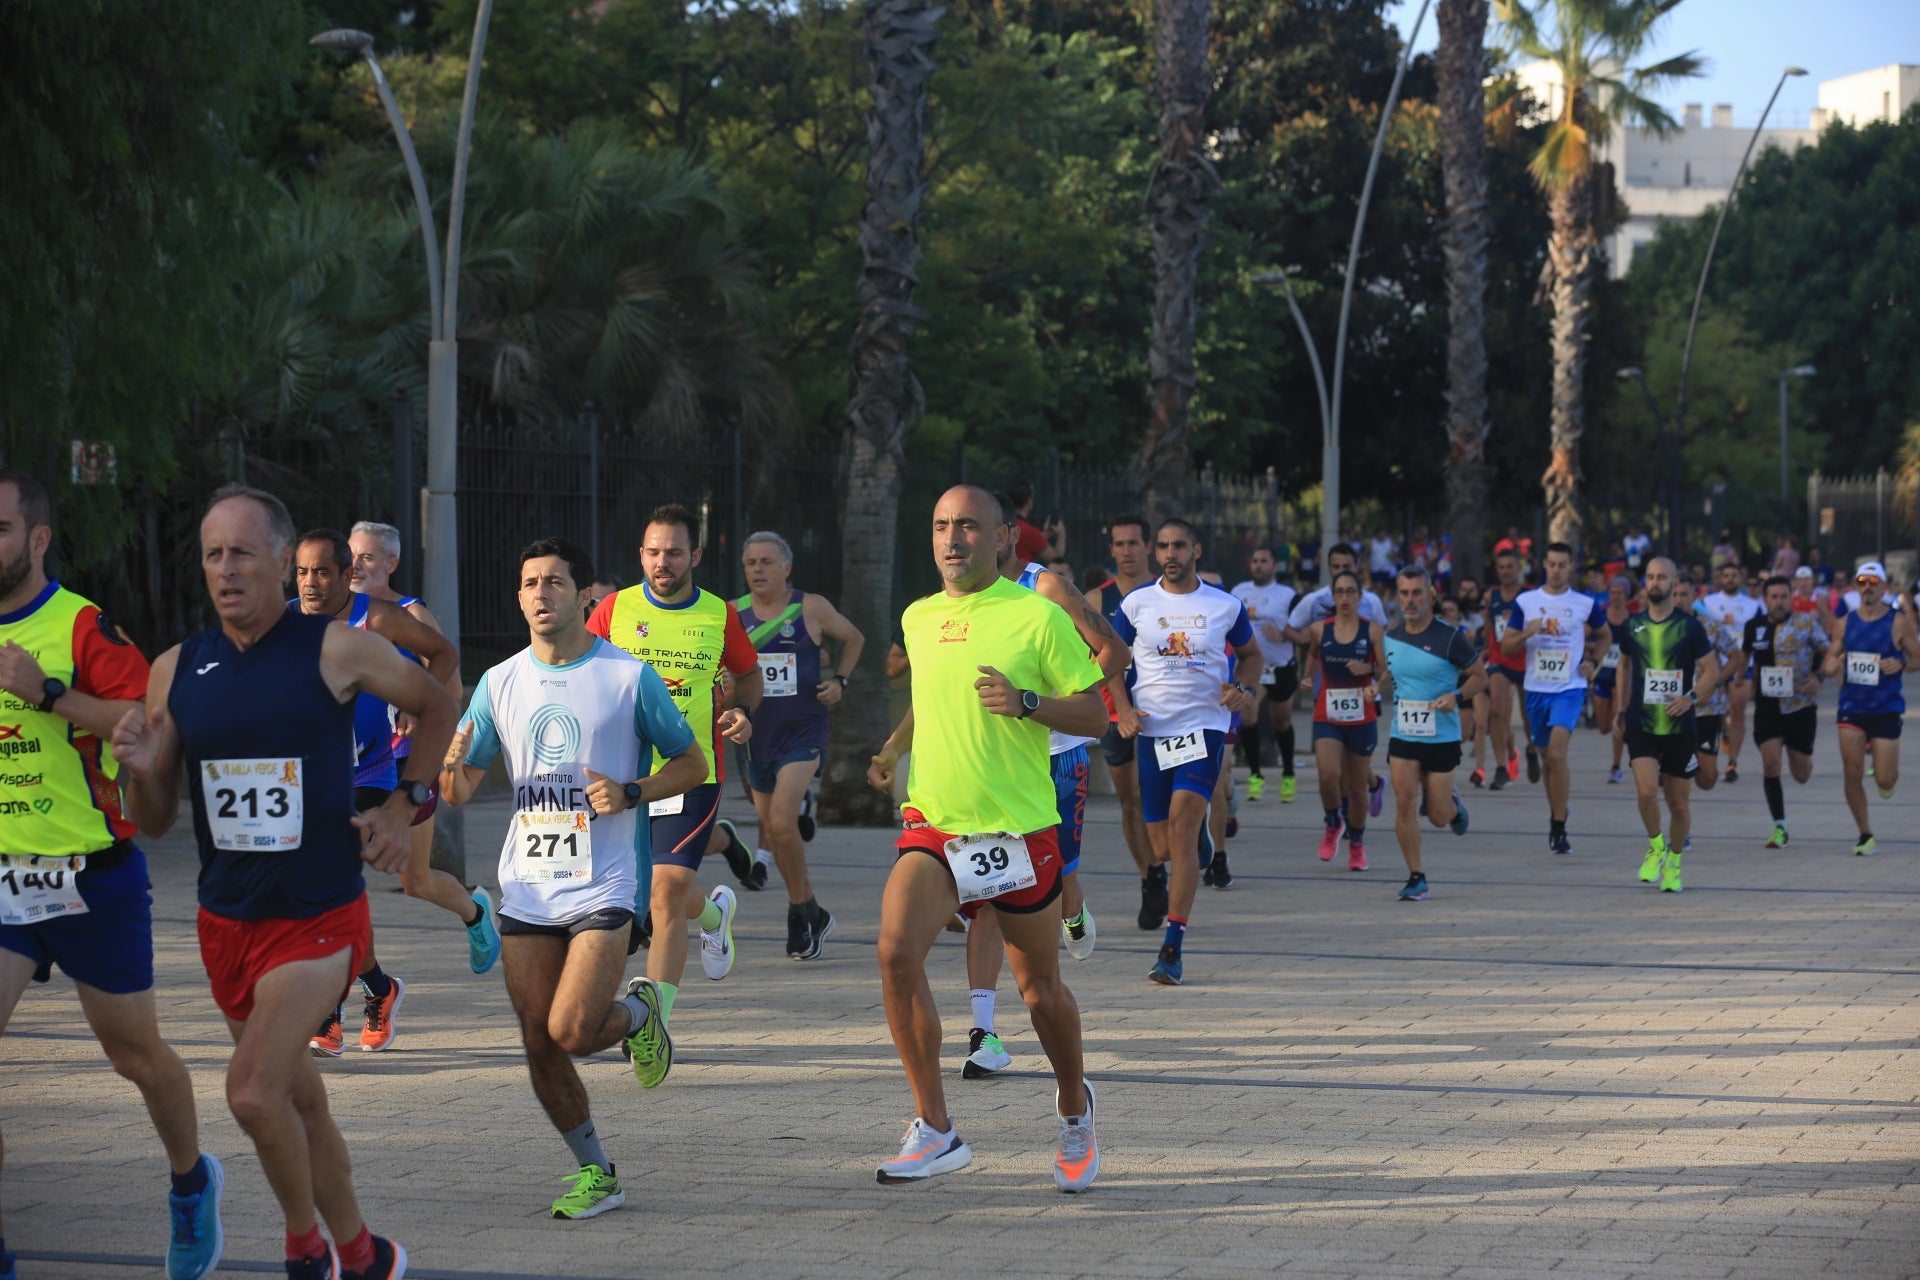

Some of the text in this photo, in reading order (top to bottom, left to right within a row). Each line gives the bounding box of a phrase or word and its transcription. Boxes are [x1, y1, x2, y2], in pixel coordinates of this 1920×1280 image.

[654, 649, 712, 661] TRIATLÓN
[640, 659, 707, 671] RTO REAL
[1539, 659, 1565, 671] 307
[1852, 662, 1875, 674] 100
[1649, 680, 1678, 692] 238
[1768, 676, 1783, 687] 51
[669, 686, 692, 697] esal
[1331, 698, 1359, 711] 163
[1402, 711, 1430, 724] 117
[1161, 732, 1197, 752] 121
[534, 773, 573, 784] INSTITUTO
[215, 787, 290, 818] 213
[553, 814, 572, 824] VERDE
[526, 832, 578, 858] 271
[970, 846, 1010, 877] 39
[1, 869, 65, 897] 140
